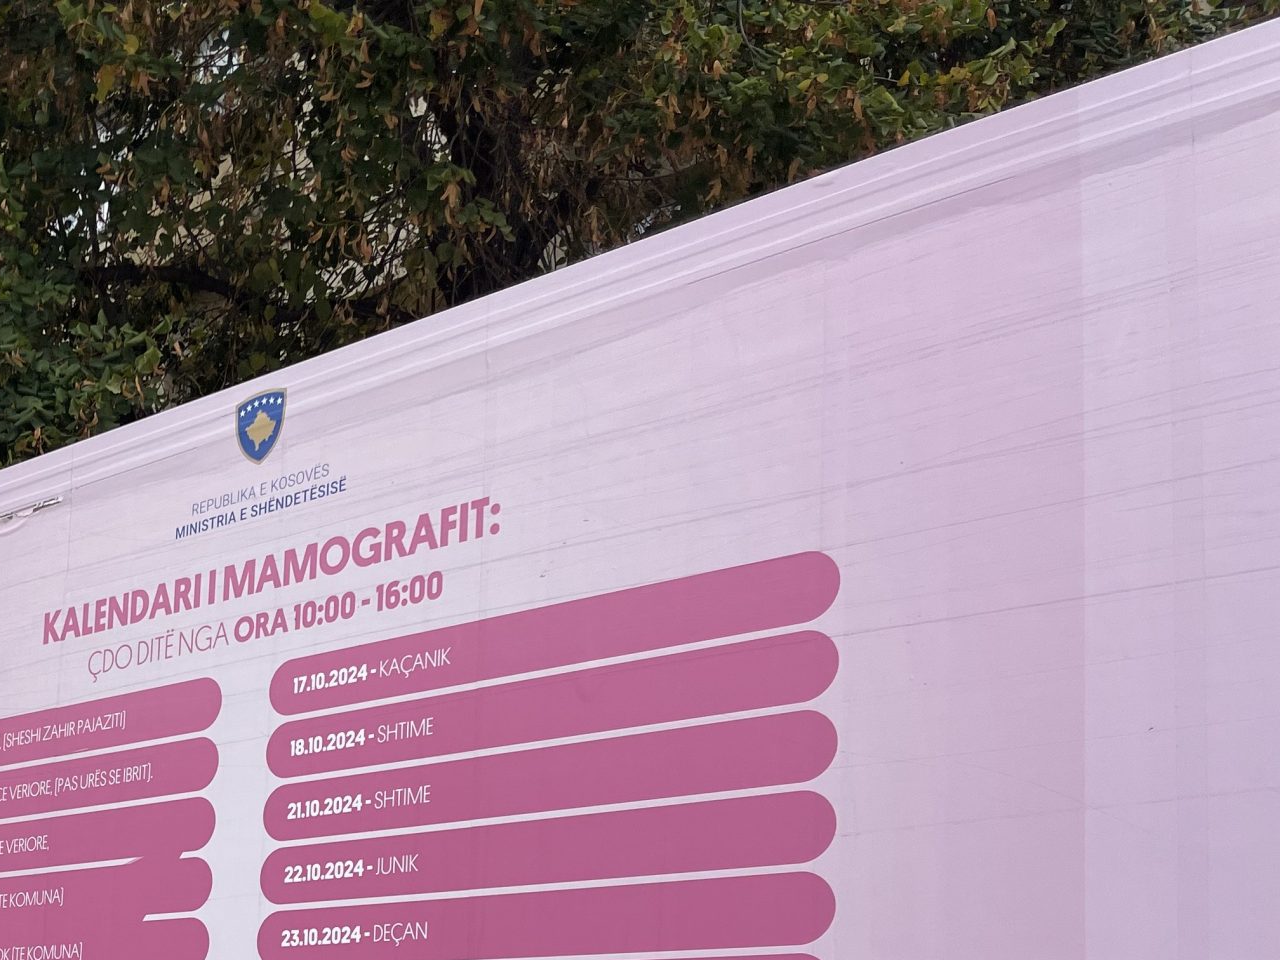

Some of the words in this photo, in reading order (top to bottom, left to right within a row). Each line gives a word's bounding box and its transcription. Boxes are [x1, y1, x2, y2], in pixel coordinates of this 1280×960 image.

[176, 511, 236, 540] MINISTRIA
[240, 507, 247, 521] E
[251, 475, 346, 517] SHËNDETËSISË
[192, 486, 258, 521] REPUBLIKA
[260, 482, 267, 496] E
[271, 463, 329, 498] KOSOVËS
[43, 573, 202, 645] KALENDARI
[208, 569, 216, 605] I
[223, 496, 500, 606] MAMOGRAFIT:
[88, 644, 132, 683] ÇDO
[137, 629, 174, 665] DITË
[179, 622, 229, 656] NGA
[234, 608, 288, 643] ORA
[294, 591, 356, 630] 10:00
[376, 571, 443, 612] 16:00
[294, 664, 368, 694] 17.10.2024
[380, 647, 451, 678] KAÇANIK
[43, 722, 75, 740] ZAHIR
[77, 711, 125, 734] PAJAZITI]
[291, 729, 365, 756] 18.10.2024
[377, 717, 433, 743] SHTIME
[10, 780, 52, 799] VERIORE,
[80, 769, 106, 789] URËS
[109, 769, 121, 785] SE
[287, 794, 362, 819] 21.10.2024
[374, 785, 430, 809] SHTIME
[6, 835, 49, 853] VERIORE,
[284, 859, 364, 883] 22.10.2024
[376, 854, 418, 875] JUNIK
[9, 887, 63, 907] KOMUNA]
[281, 926, 361, 947] 23.10.2024
[374, 922, 427, 946] DEÇAN
[27, 942, 82, 960] KOMUNA]
